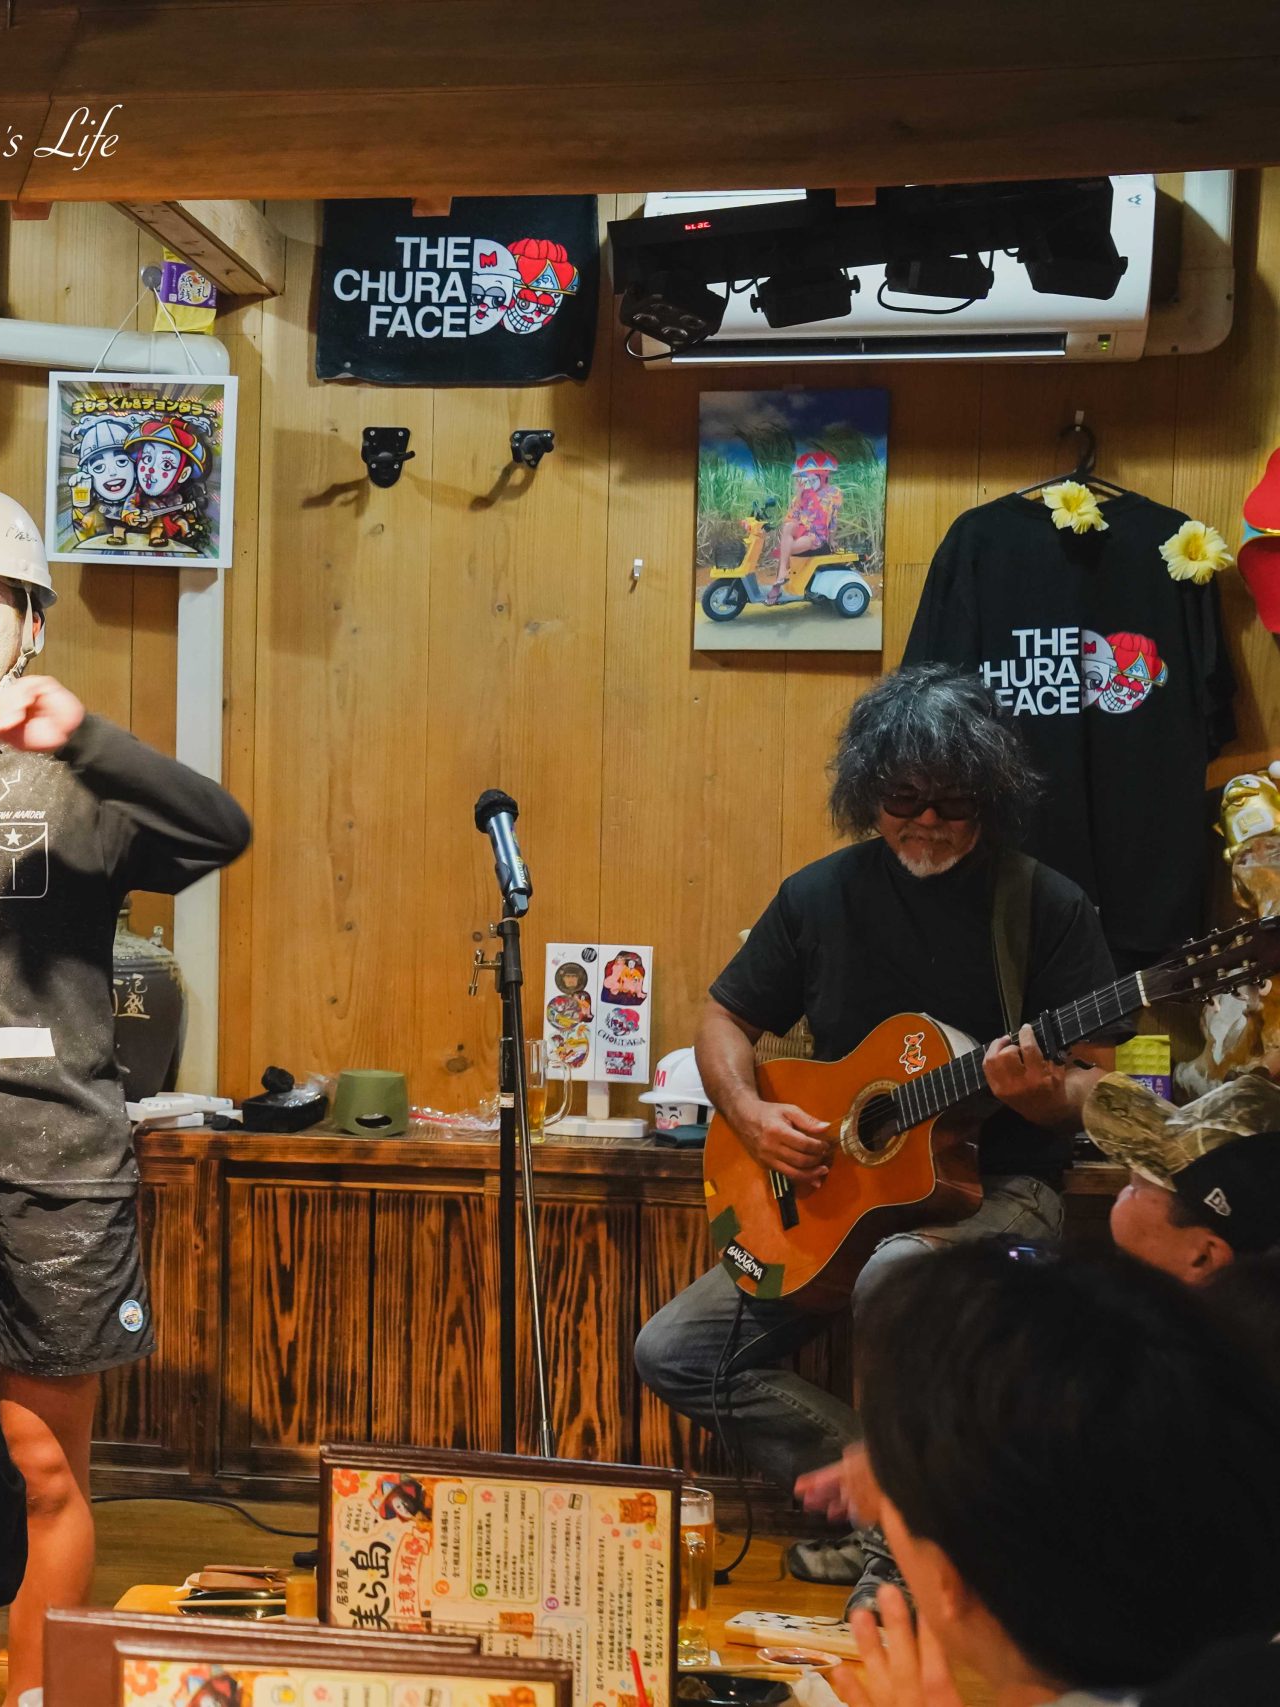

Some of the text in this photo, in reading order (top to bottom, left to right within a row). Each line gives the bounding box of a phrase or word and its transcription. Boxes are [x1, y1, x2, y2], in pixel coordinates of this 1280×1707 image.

[395, 236, 471, 269] THE
[333, 268, 467, 304] CHURA
[368, 305, 467, 338] FACE
[1012, 627, 1079, 657] THE
[978, 658, 1080, 689] HURA
[654, 1070, 666, 1088] M
[336, 1568, 349, 1606] 居酒屋
